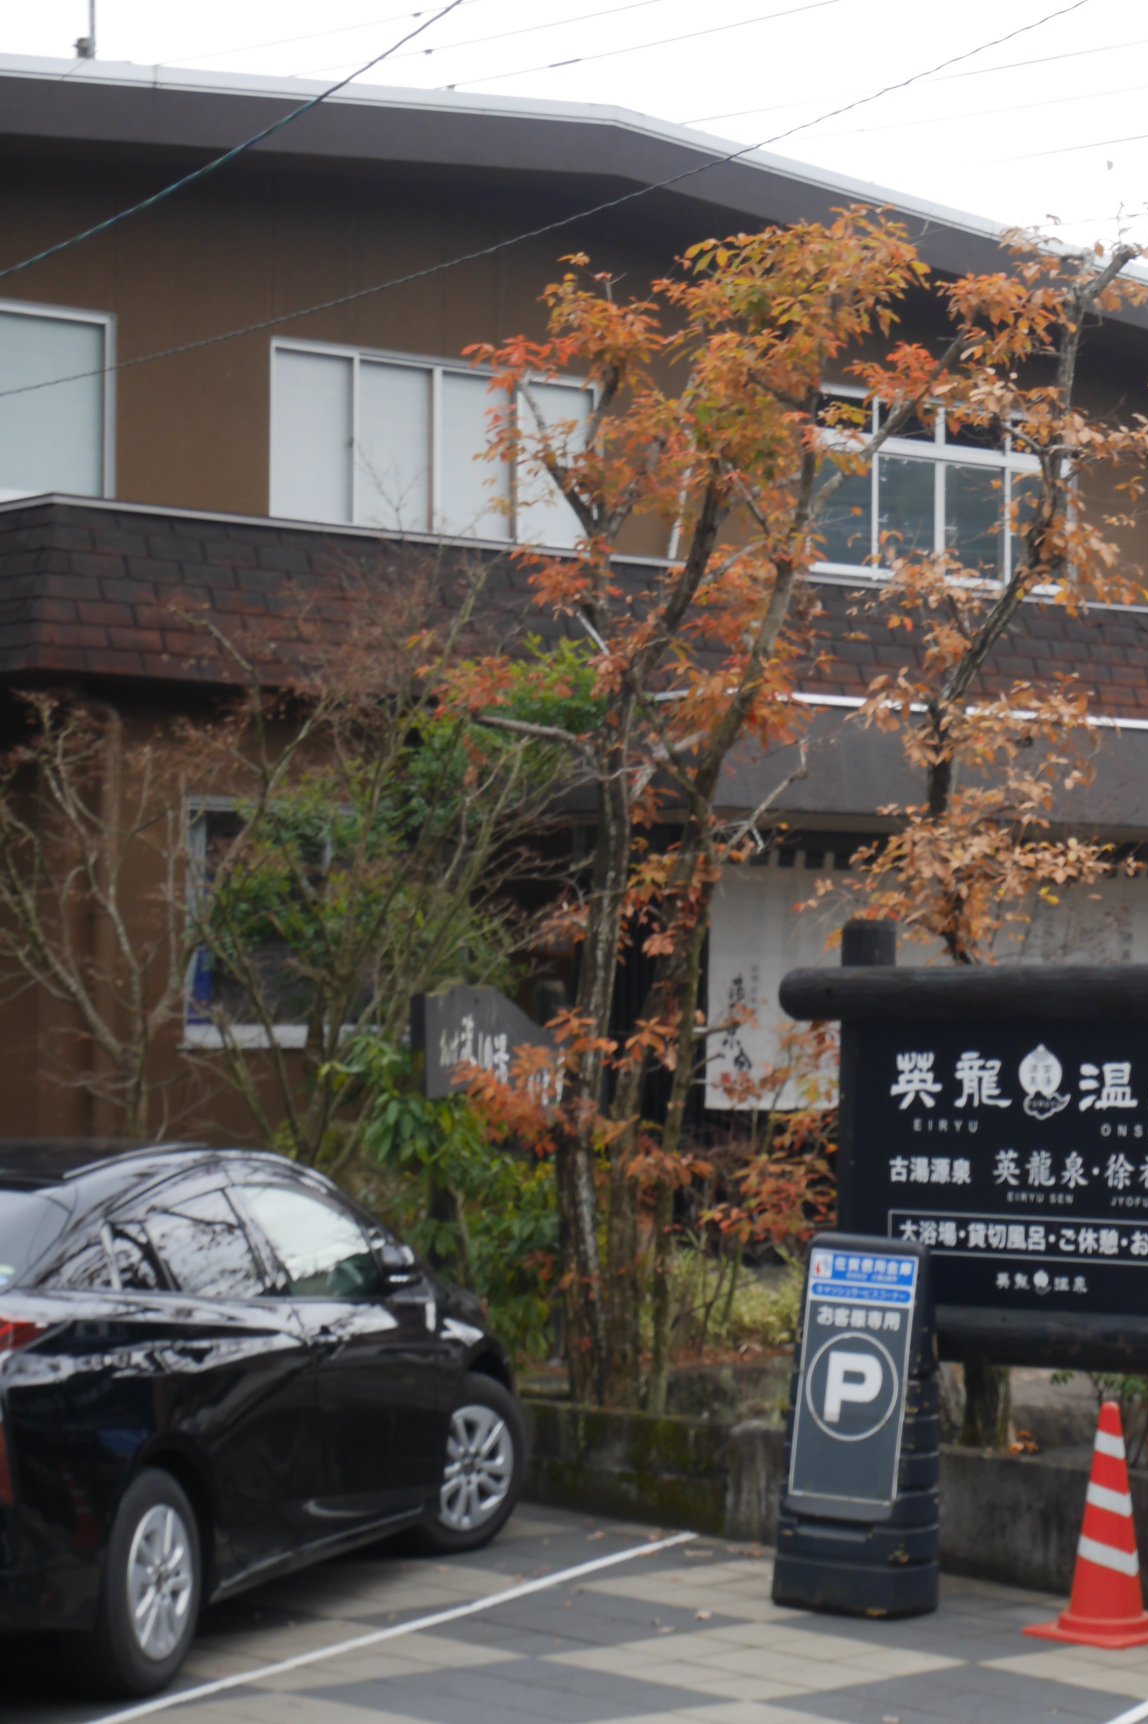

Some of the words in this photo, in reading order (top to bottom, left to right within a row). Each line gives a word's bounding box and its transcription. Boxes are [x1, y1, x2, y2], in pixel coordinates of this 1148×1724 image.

[913, 1118, 979, 1133] EIRYU
[1007, 1191, 1044, 1203] EIRYU
[1049, 1193, 1074, 1205] SEN
[824, 1351, 883, 1423] P
